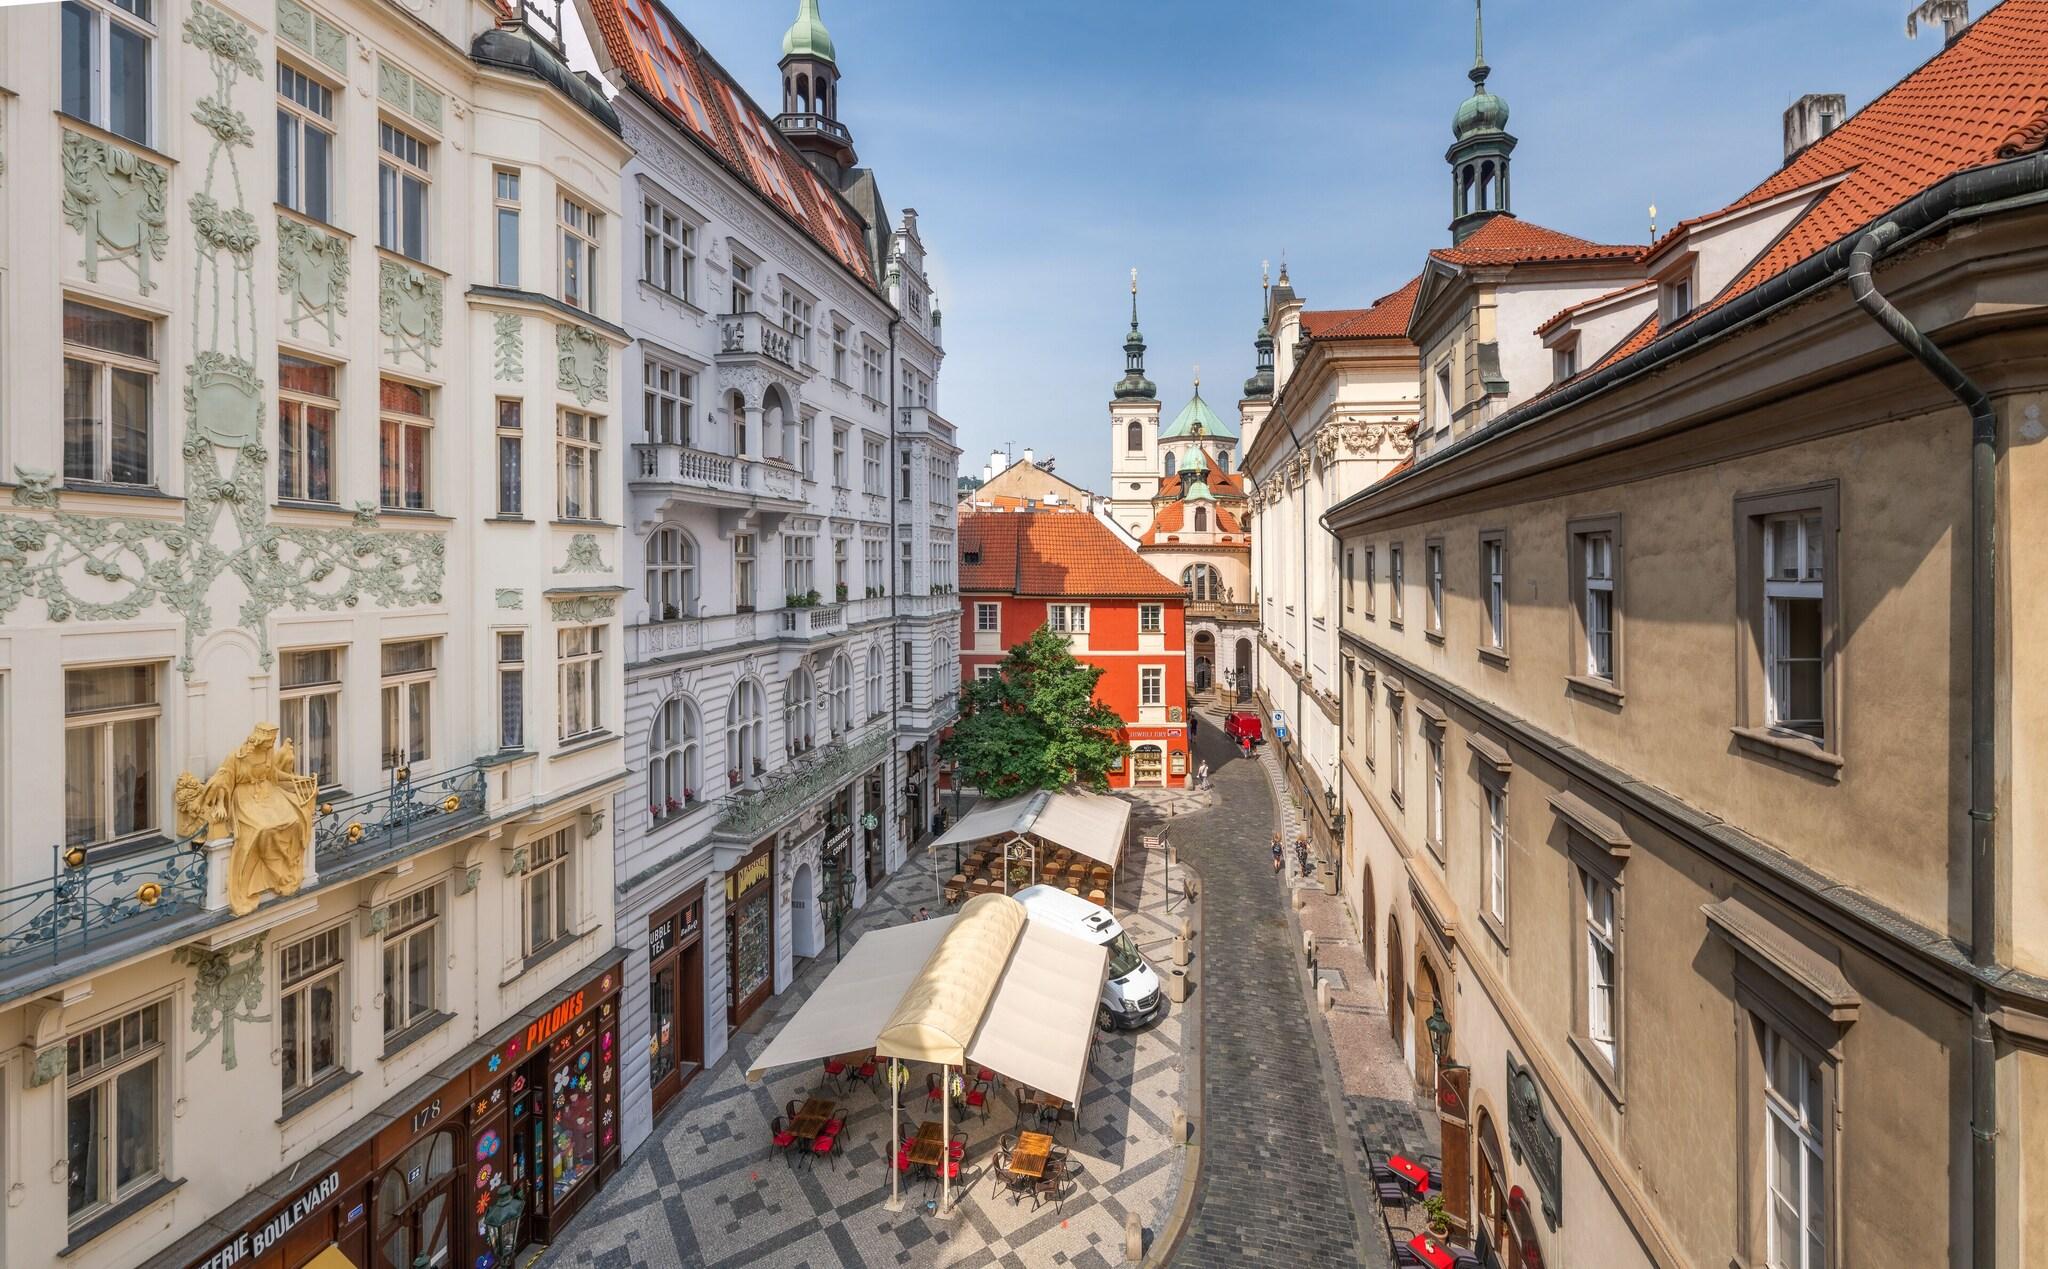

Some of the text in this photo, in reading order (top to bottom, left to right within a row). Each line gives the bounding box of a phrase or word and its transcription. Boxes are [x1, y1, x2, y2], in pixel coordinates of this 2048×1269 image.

[827, 824, 850, 849] STARBUCKS
[833, 838, 848, 856] COFFEE
[740, 853, 769, 881] MARKET
[652, 939, 665, 957] TEA
[526, 990, 584, 1053] PYLONES
[413, 1099, 441, 1133] 178
[252, 1171, 339, 1259] BOULEVARD
